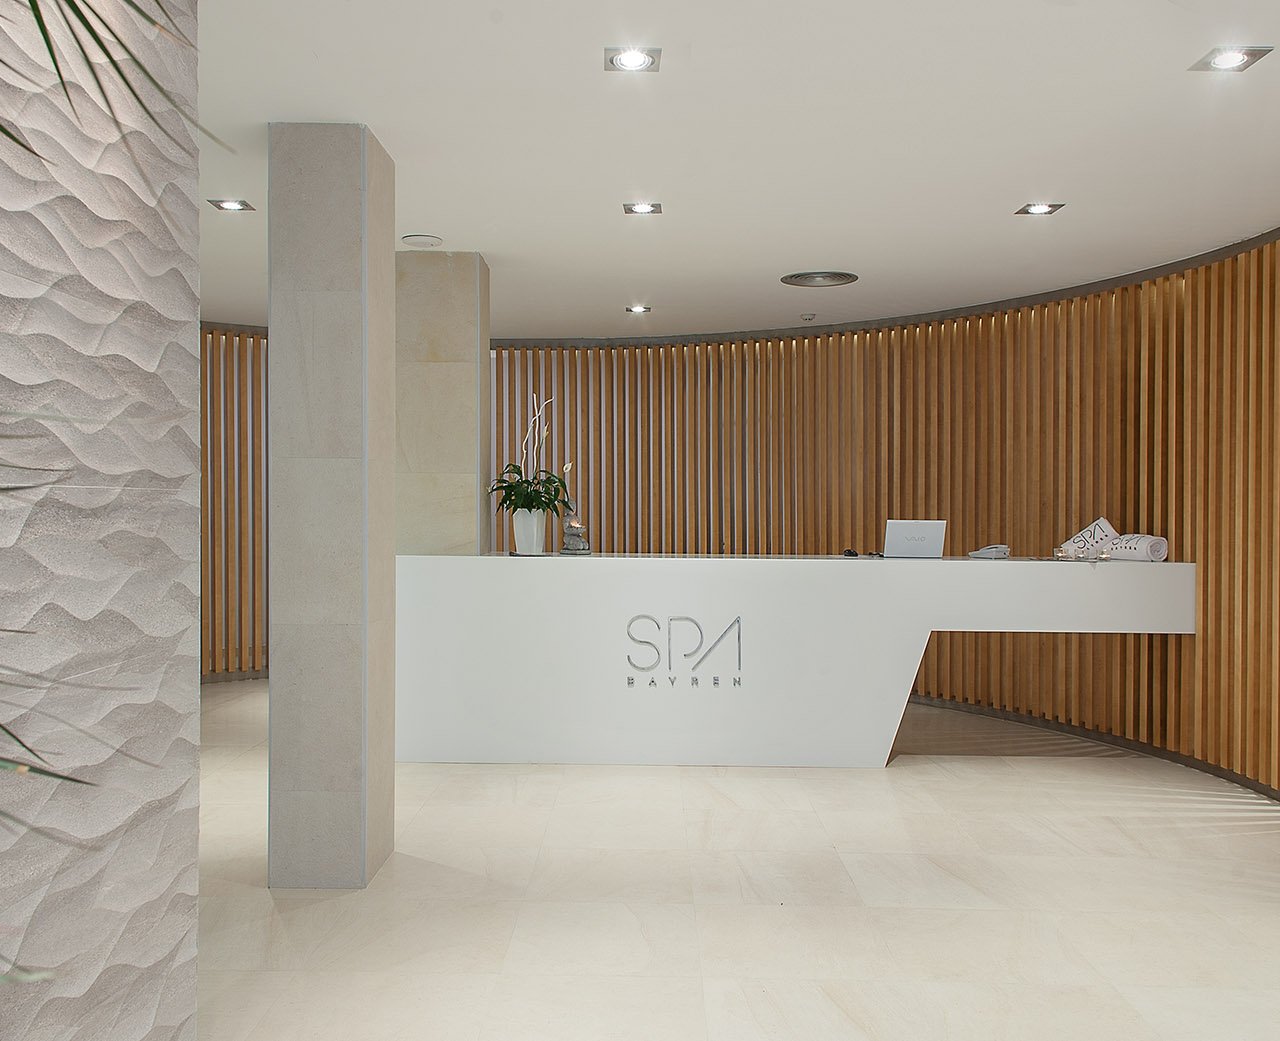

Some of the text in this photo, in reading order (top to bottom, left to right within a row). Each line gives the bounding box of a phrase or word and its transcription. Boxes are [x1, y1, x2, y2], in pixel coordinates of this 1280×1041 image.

[1072, 523, 1105, 549] SPA
[626, 614, 741, 672] SPA
[626, 676, 742, 688] BAYREN
